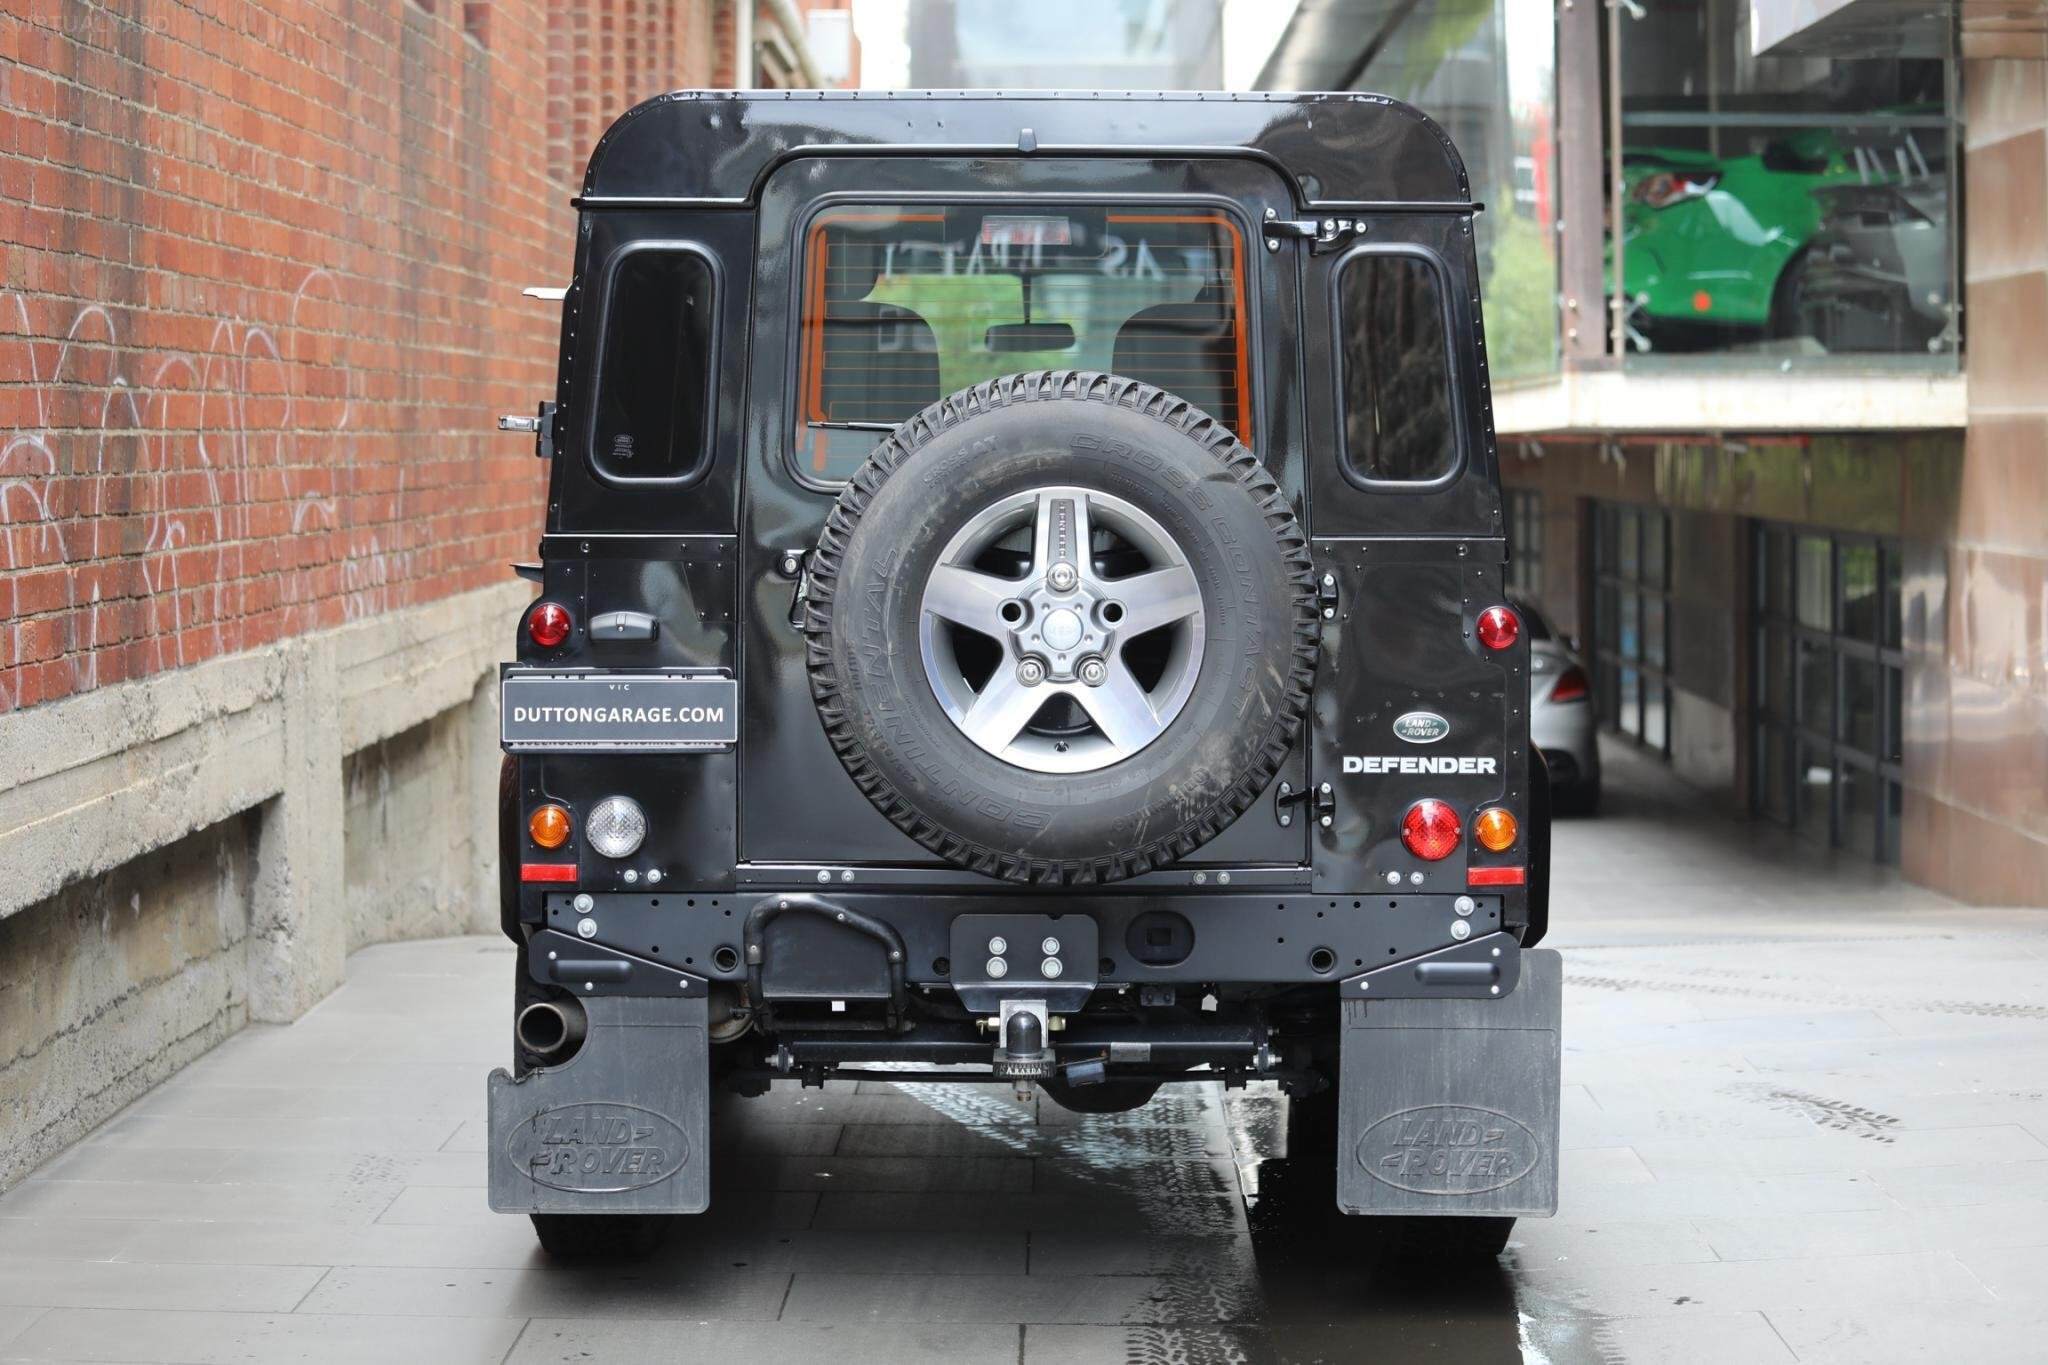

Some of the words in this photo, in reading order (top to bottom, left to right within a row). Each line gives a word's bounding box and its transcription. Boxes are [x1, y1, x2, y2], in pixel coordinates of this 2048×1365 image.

[1070, 433, 1213, 511] CROSS
[862, 550, 1051, 829] CONTINENTAL
[514, 707, 724, 723] DUTTONGARAGE.COM
[1404, 719, 1431, 728] LAND
[1406, 728, 1439, 736] ROVER
[1343, 756, 1497, 775] DEFENDER
[542, 1116, 633, 1145] LAND
[1393, 1119, 1484, 1147] LAND
[551, 1146, 666, 1175] ROVER
[1400, 1148, 1516, 1177] ROVER
